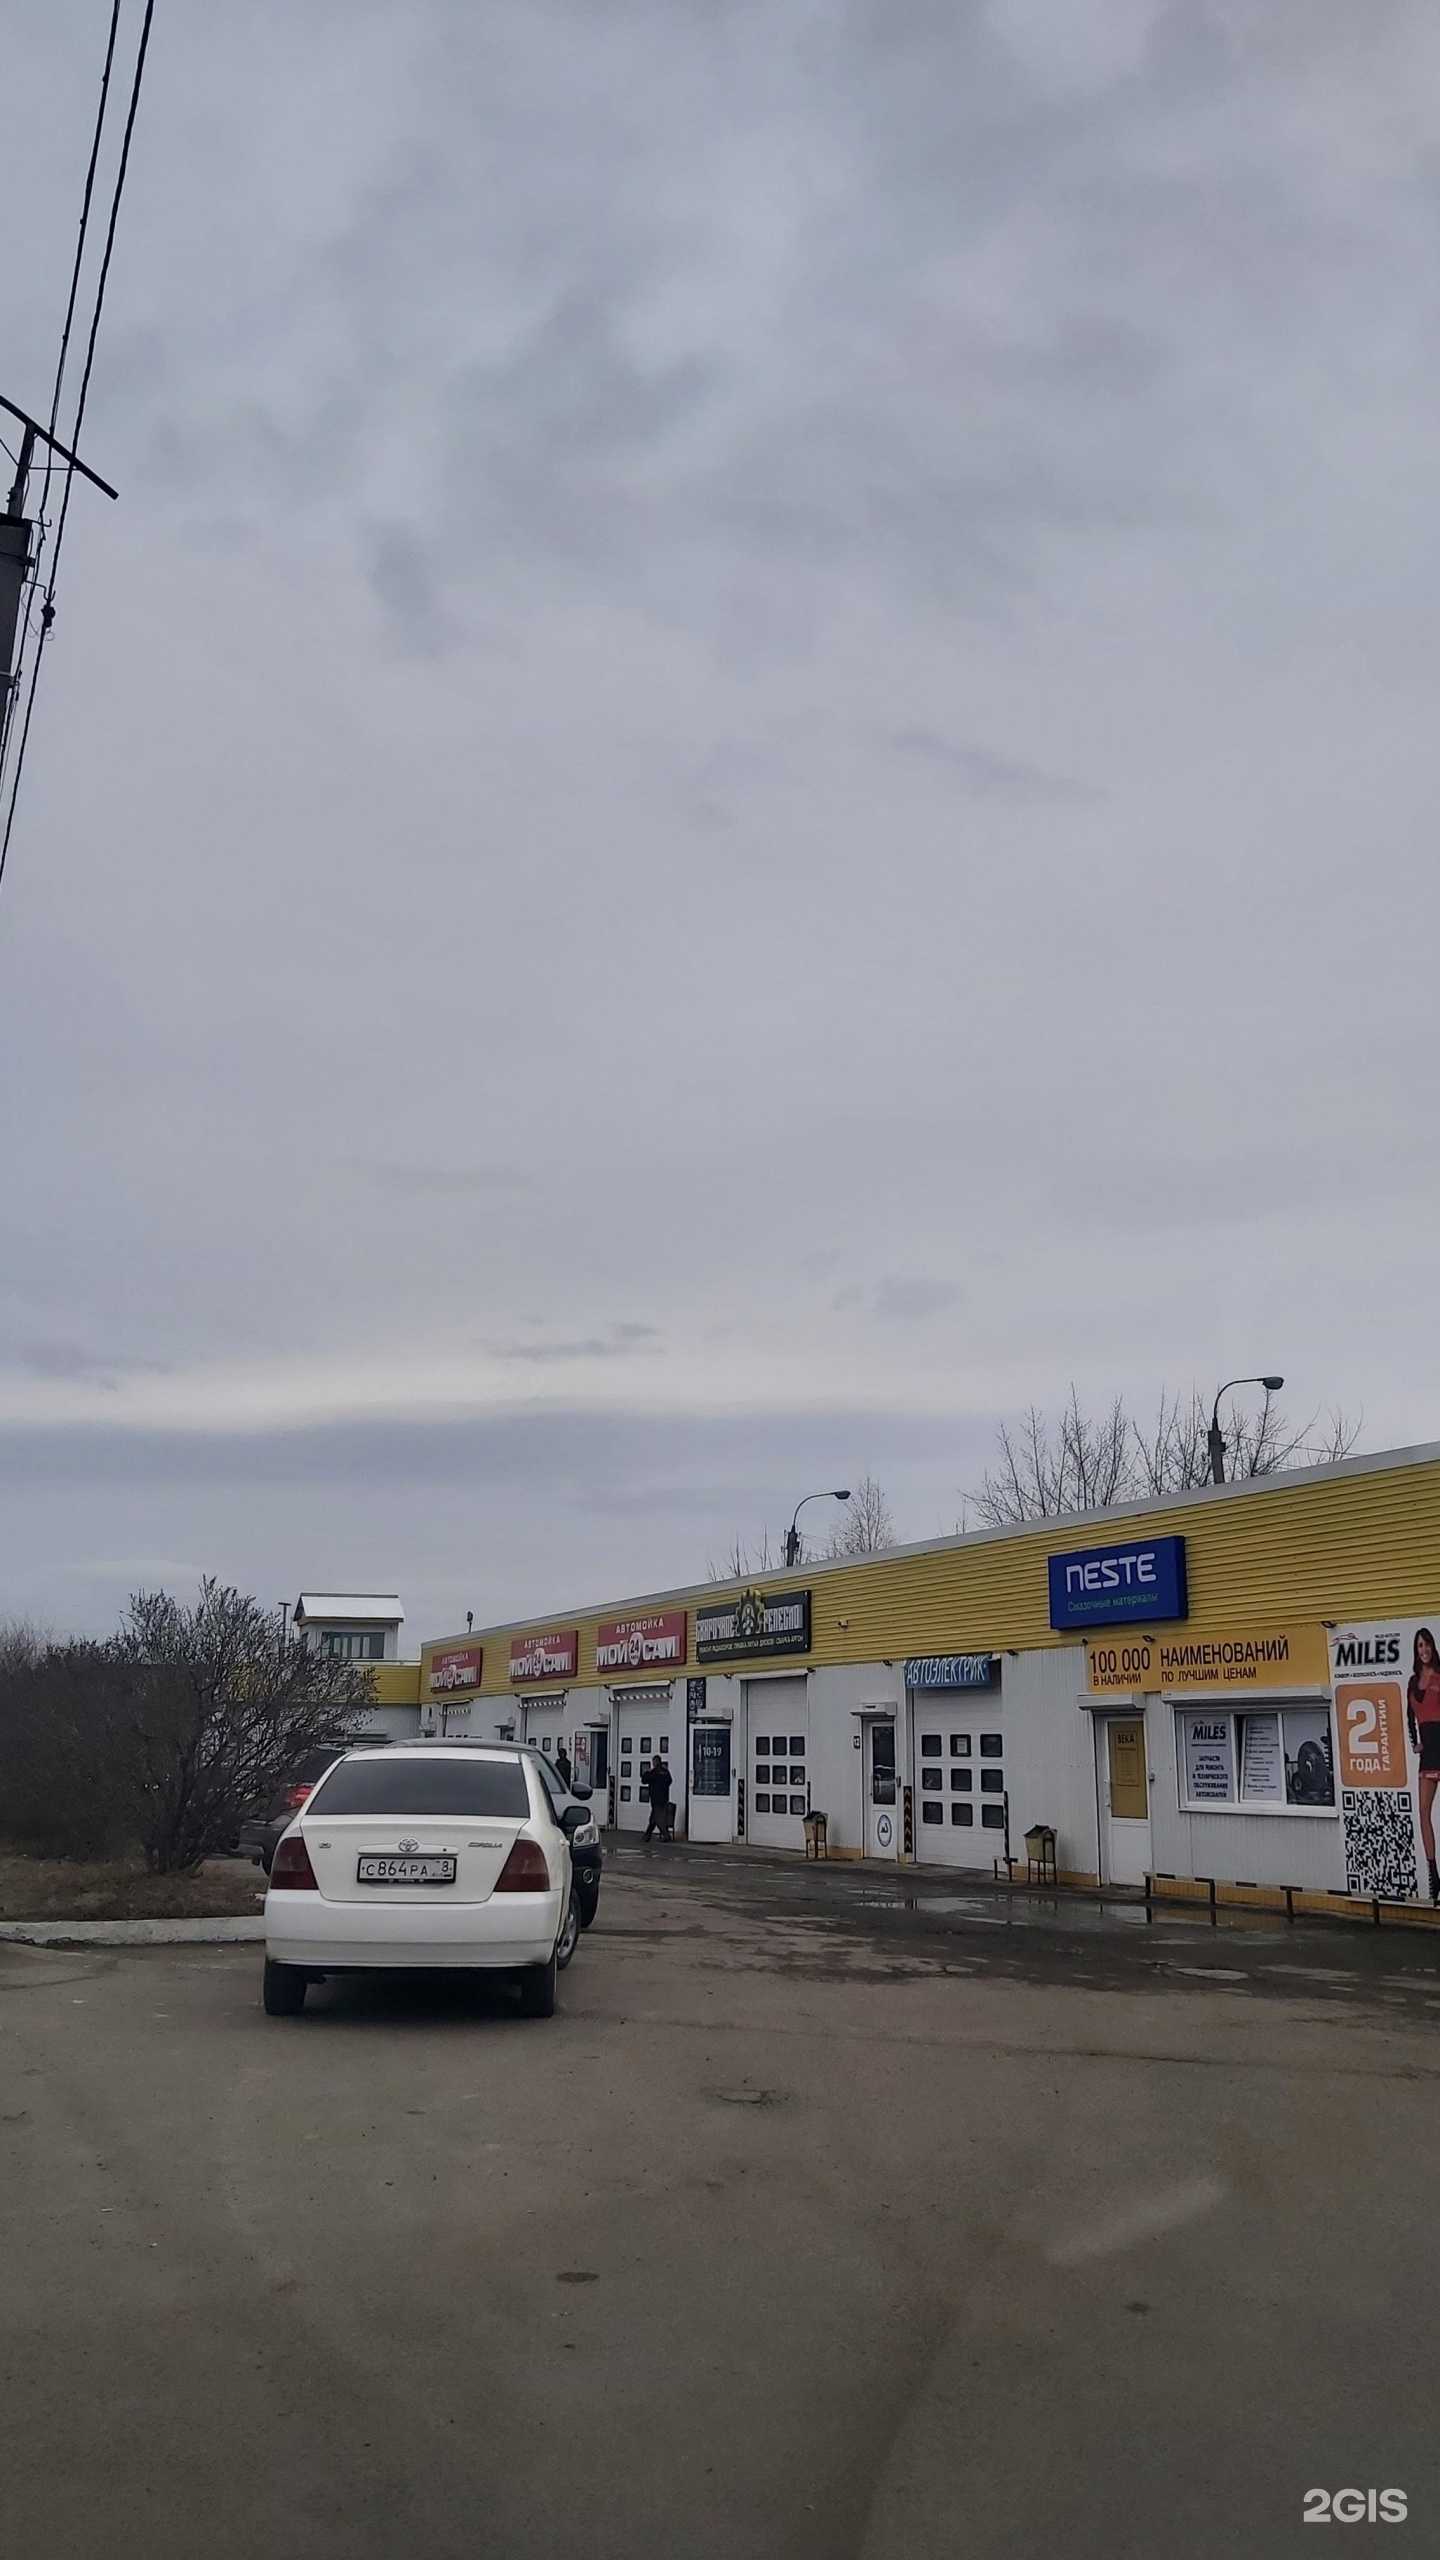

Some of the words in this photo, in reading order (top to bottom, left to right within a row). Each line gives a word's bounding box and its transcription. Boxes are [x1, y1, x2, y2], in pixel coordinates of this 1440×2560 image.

[1066, 1552, 1157, 1592] NESTE
[616, 1616, 665, 1634] АВТОМОЙКА
[597, 1640, 628, 1666] МОЙ
[1090, 1650, 1117, 1674] 100
[1121, 1647, 1150, 1671] 000
[1160, 1635, 1289, 1667] НАИМЕНОВАНИЙ
[1336, 1639, 1400, 1667] MILES
[1093, 1675, 1099, 1686] В
[1101, 1674, 1142, 1685] НАЛИЧИИ
[1161, 1671, 1174, 1682] ПО
[1177, 1669, 1219, 1681] ЛУЧШИМ
[1223, 1666, 1257, 1680] ЦЕНАМ
[1192, 1726, 1226, 1740] MILES
[1347, 1699, 1379, 1754] 2
[1378, 1699, 1392, 1772] ГАРАНТИИ
[1350, 1759, 1381, 1774] ГОДА
